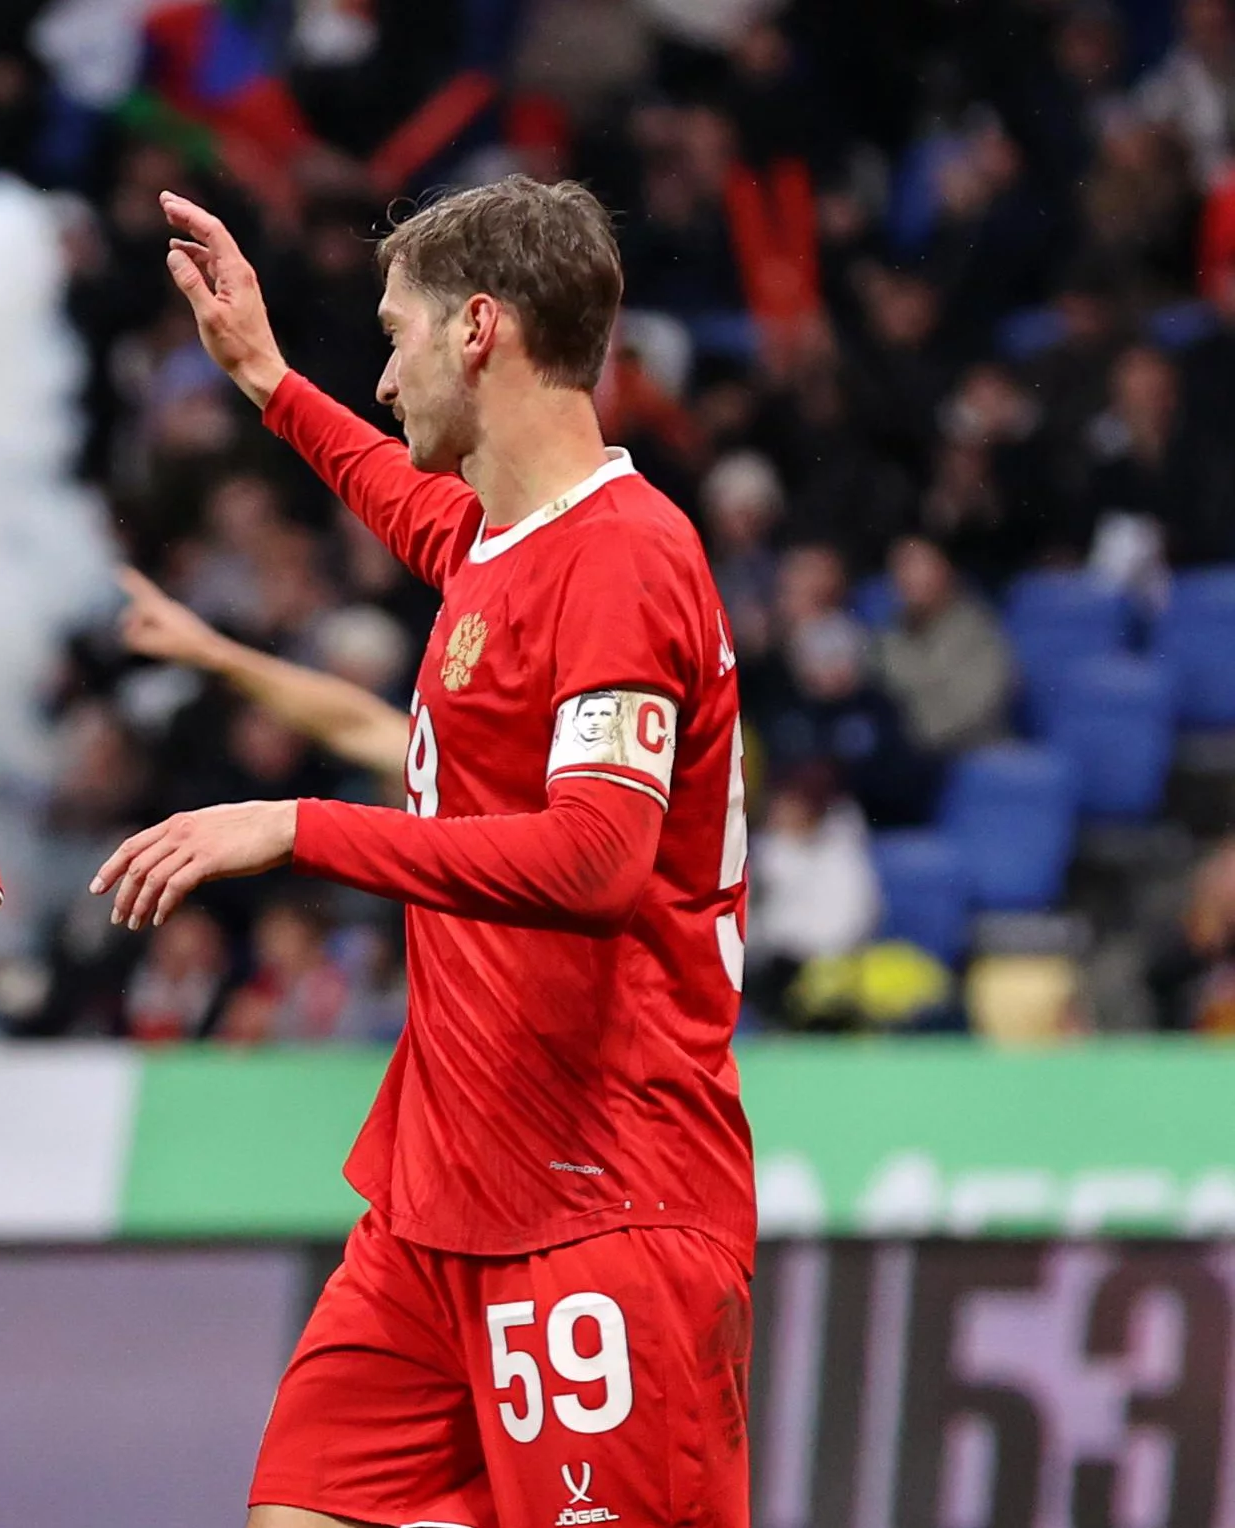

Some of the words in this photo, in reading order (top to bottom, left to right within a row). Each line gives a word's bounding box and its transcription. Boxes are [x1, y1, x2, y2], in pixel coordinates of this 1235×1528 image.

[637, 701, 666, 754] C
[486, 1291, 634, 1443] 59
[555, 1507, 620, 1526] JÖGEL
